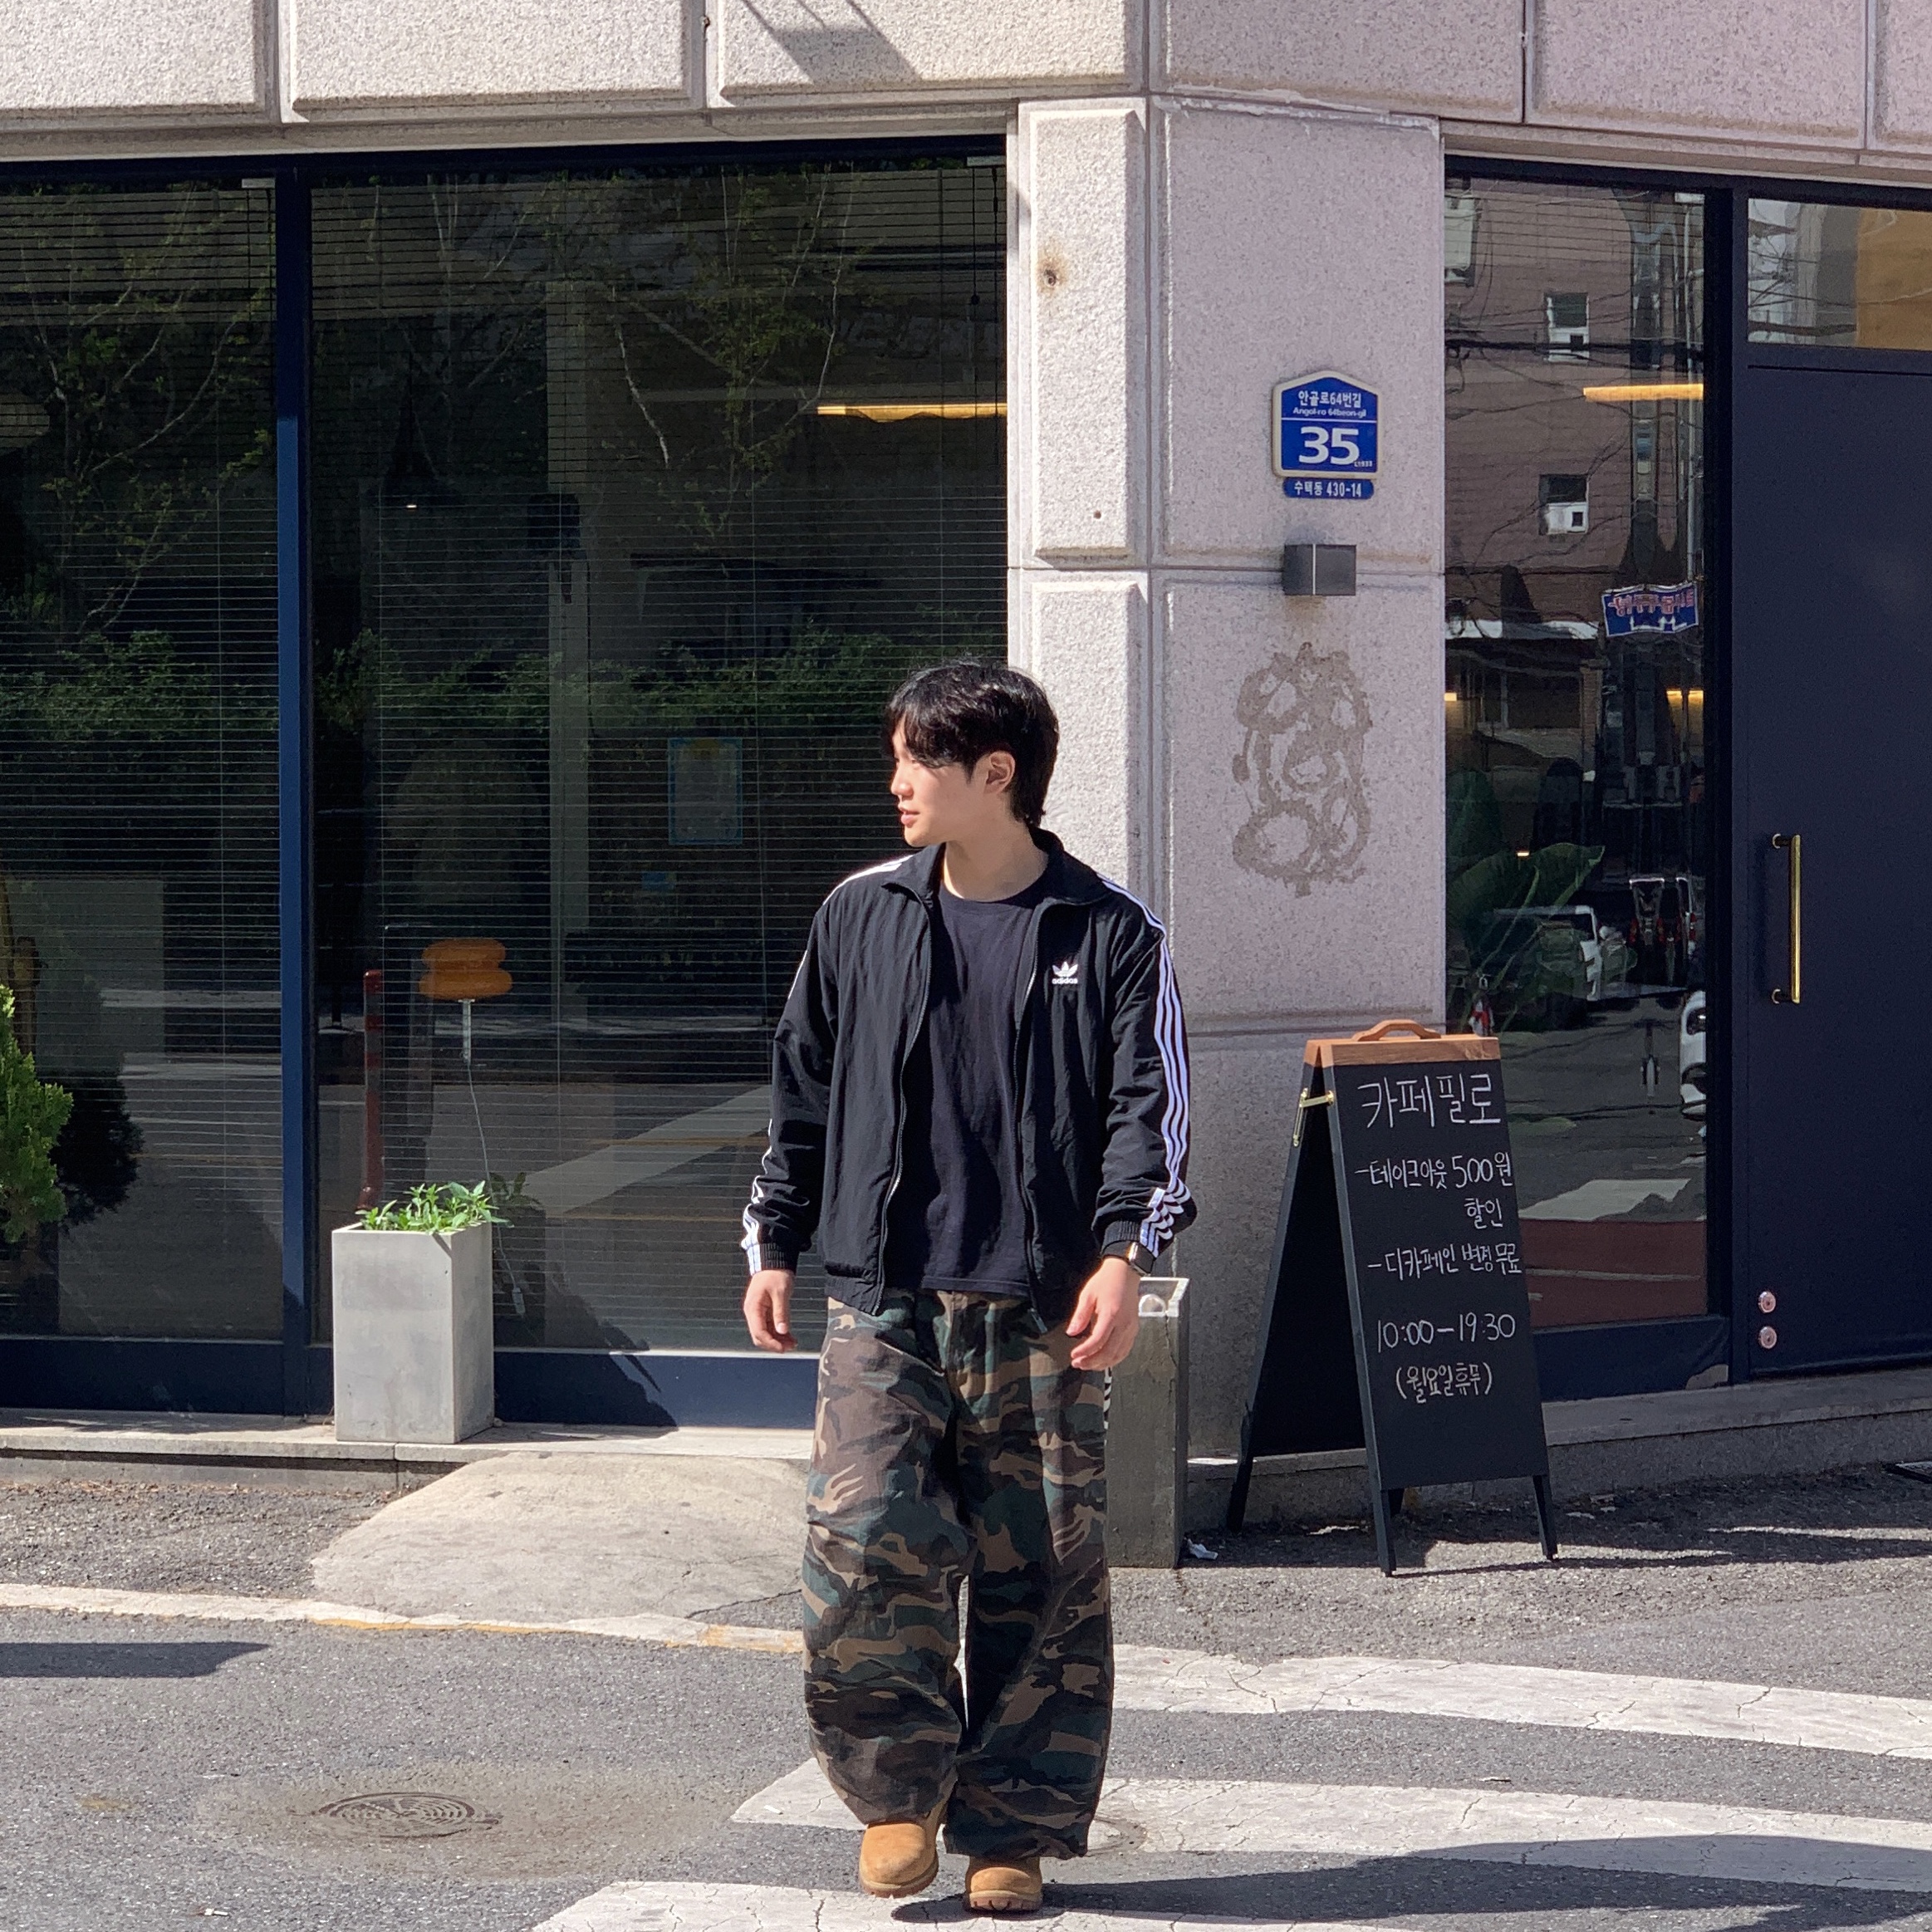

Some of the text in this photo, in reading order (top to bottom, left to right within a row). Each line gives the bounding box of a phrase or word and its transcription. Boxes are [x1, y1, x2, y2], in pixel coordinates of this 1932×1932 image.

[1297, 390, 1361, 409] 안골로64번길
[1292, 407, 1367, 419] Angol-ro 64beon-gil
[1298, 426, 1360, 465] 35
[1294, 480, 1362, 498] 수택동 430-14
[1052, 977, 1078, 985] adidas
[1464, 1197, 1503, 1229] 할인
